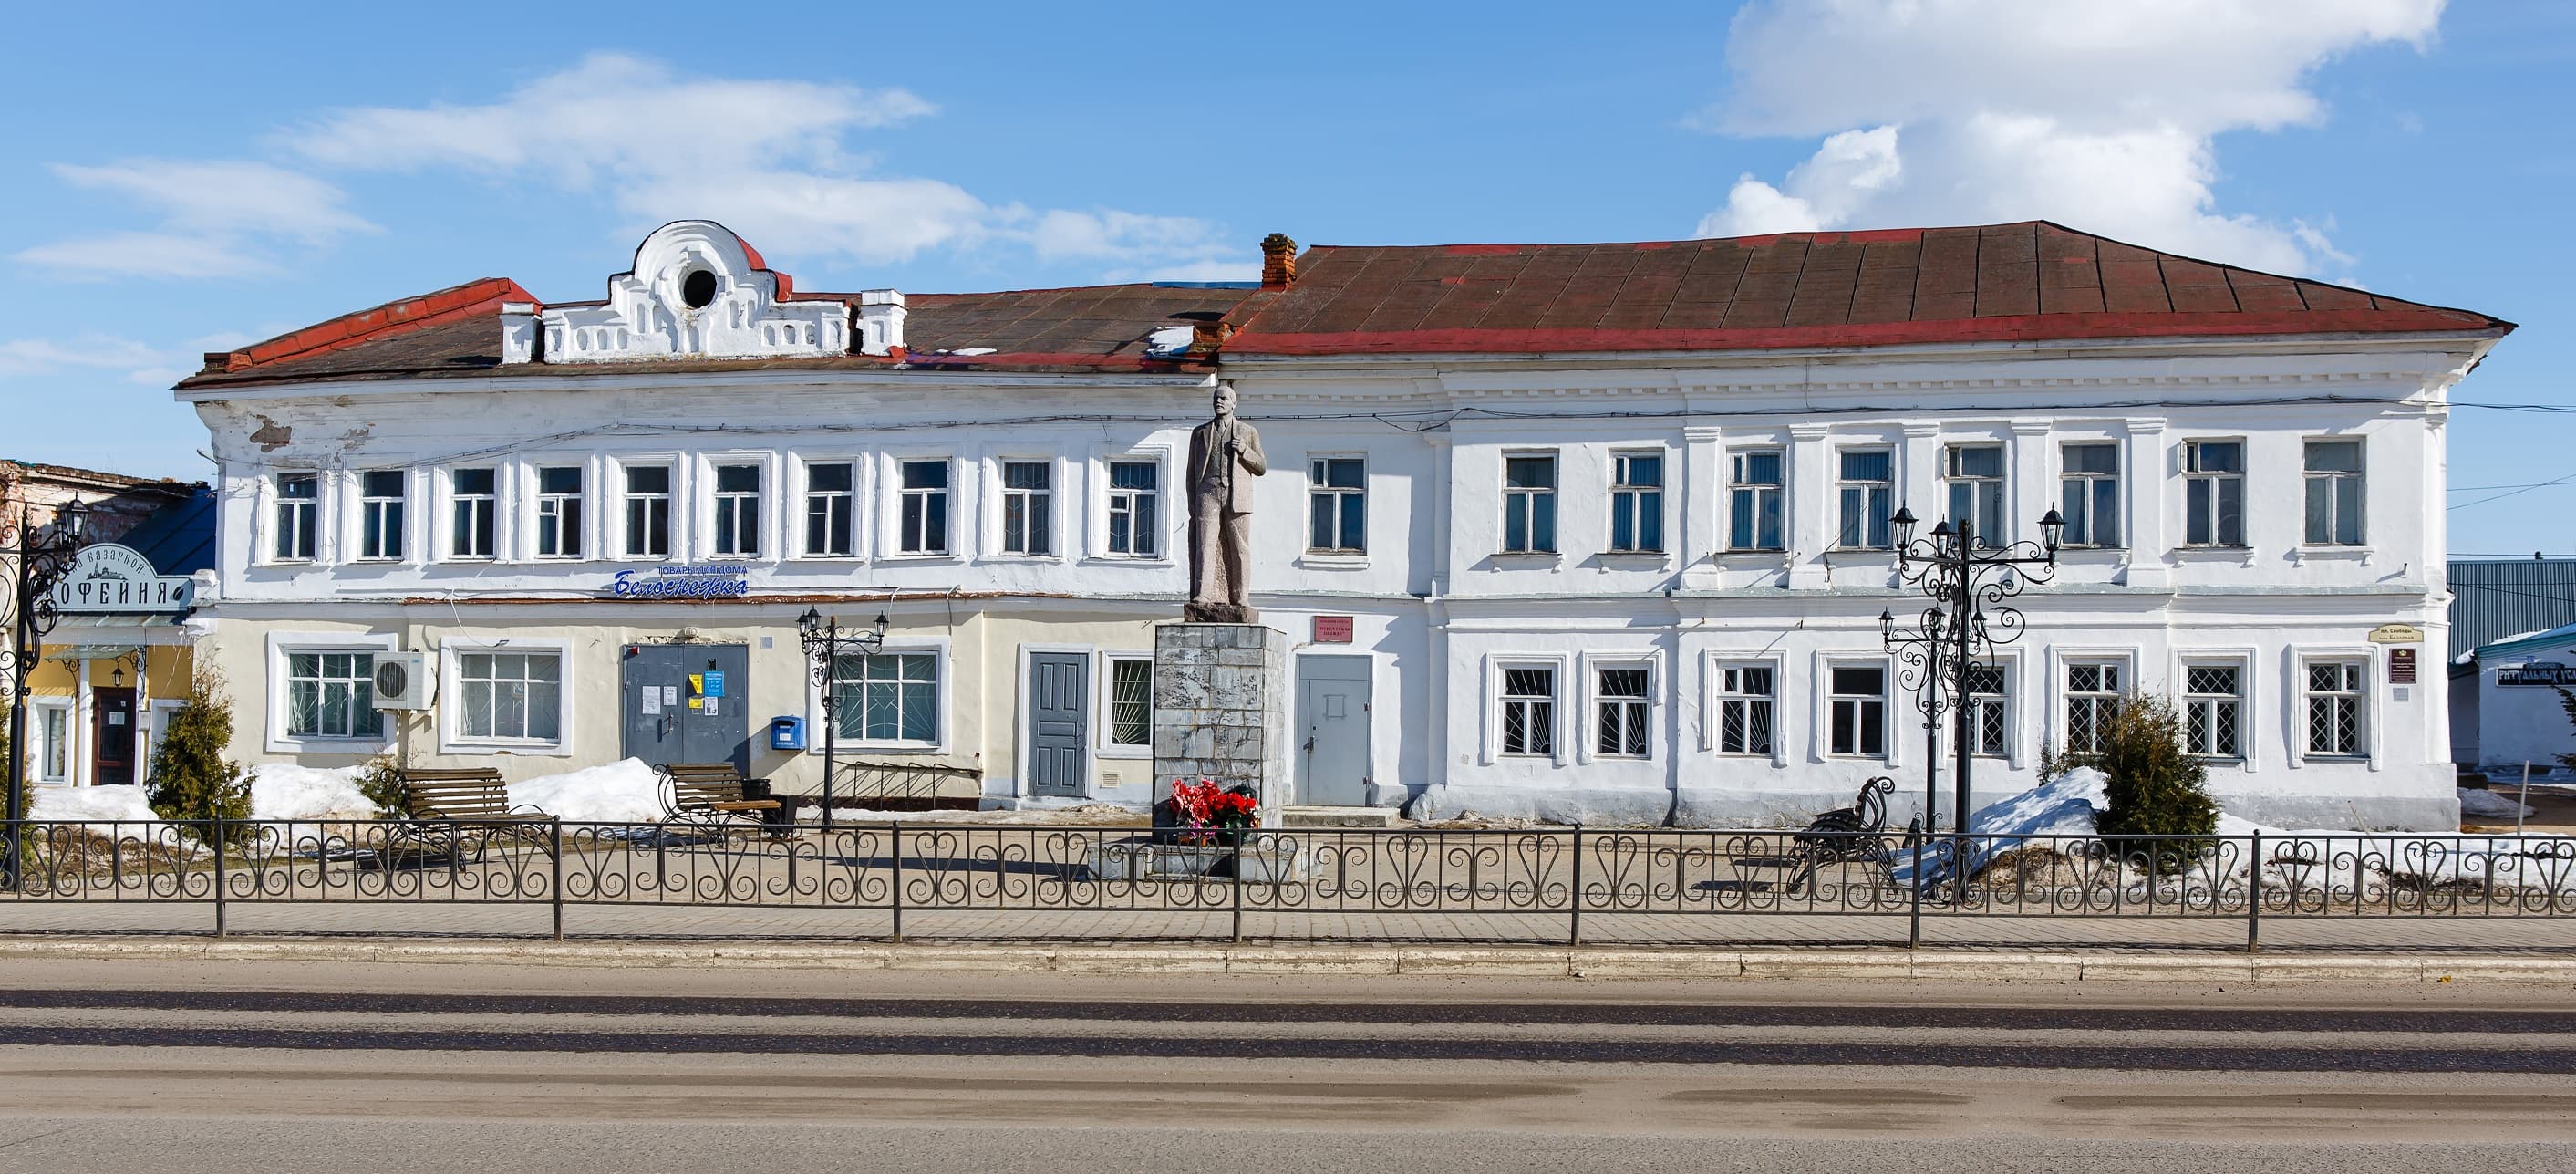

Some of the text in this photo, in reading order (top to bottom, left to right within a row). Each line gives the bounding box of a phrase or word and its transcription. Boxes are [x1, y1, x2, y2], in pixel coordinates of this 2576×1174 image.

[657, 566, 748, 577] ТОВАРЫ ДЛЯ ДОМА
[614, 569, 749, 599] Белоснежка
